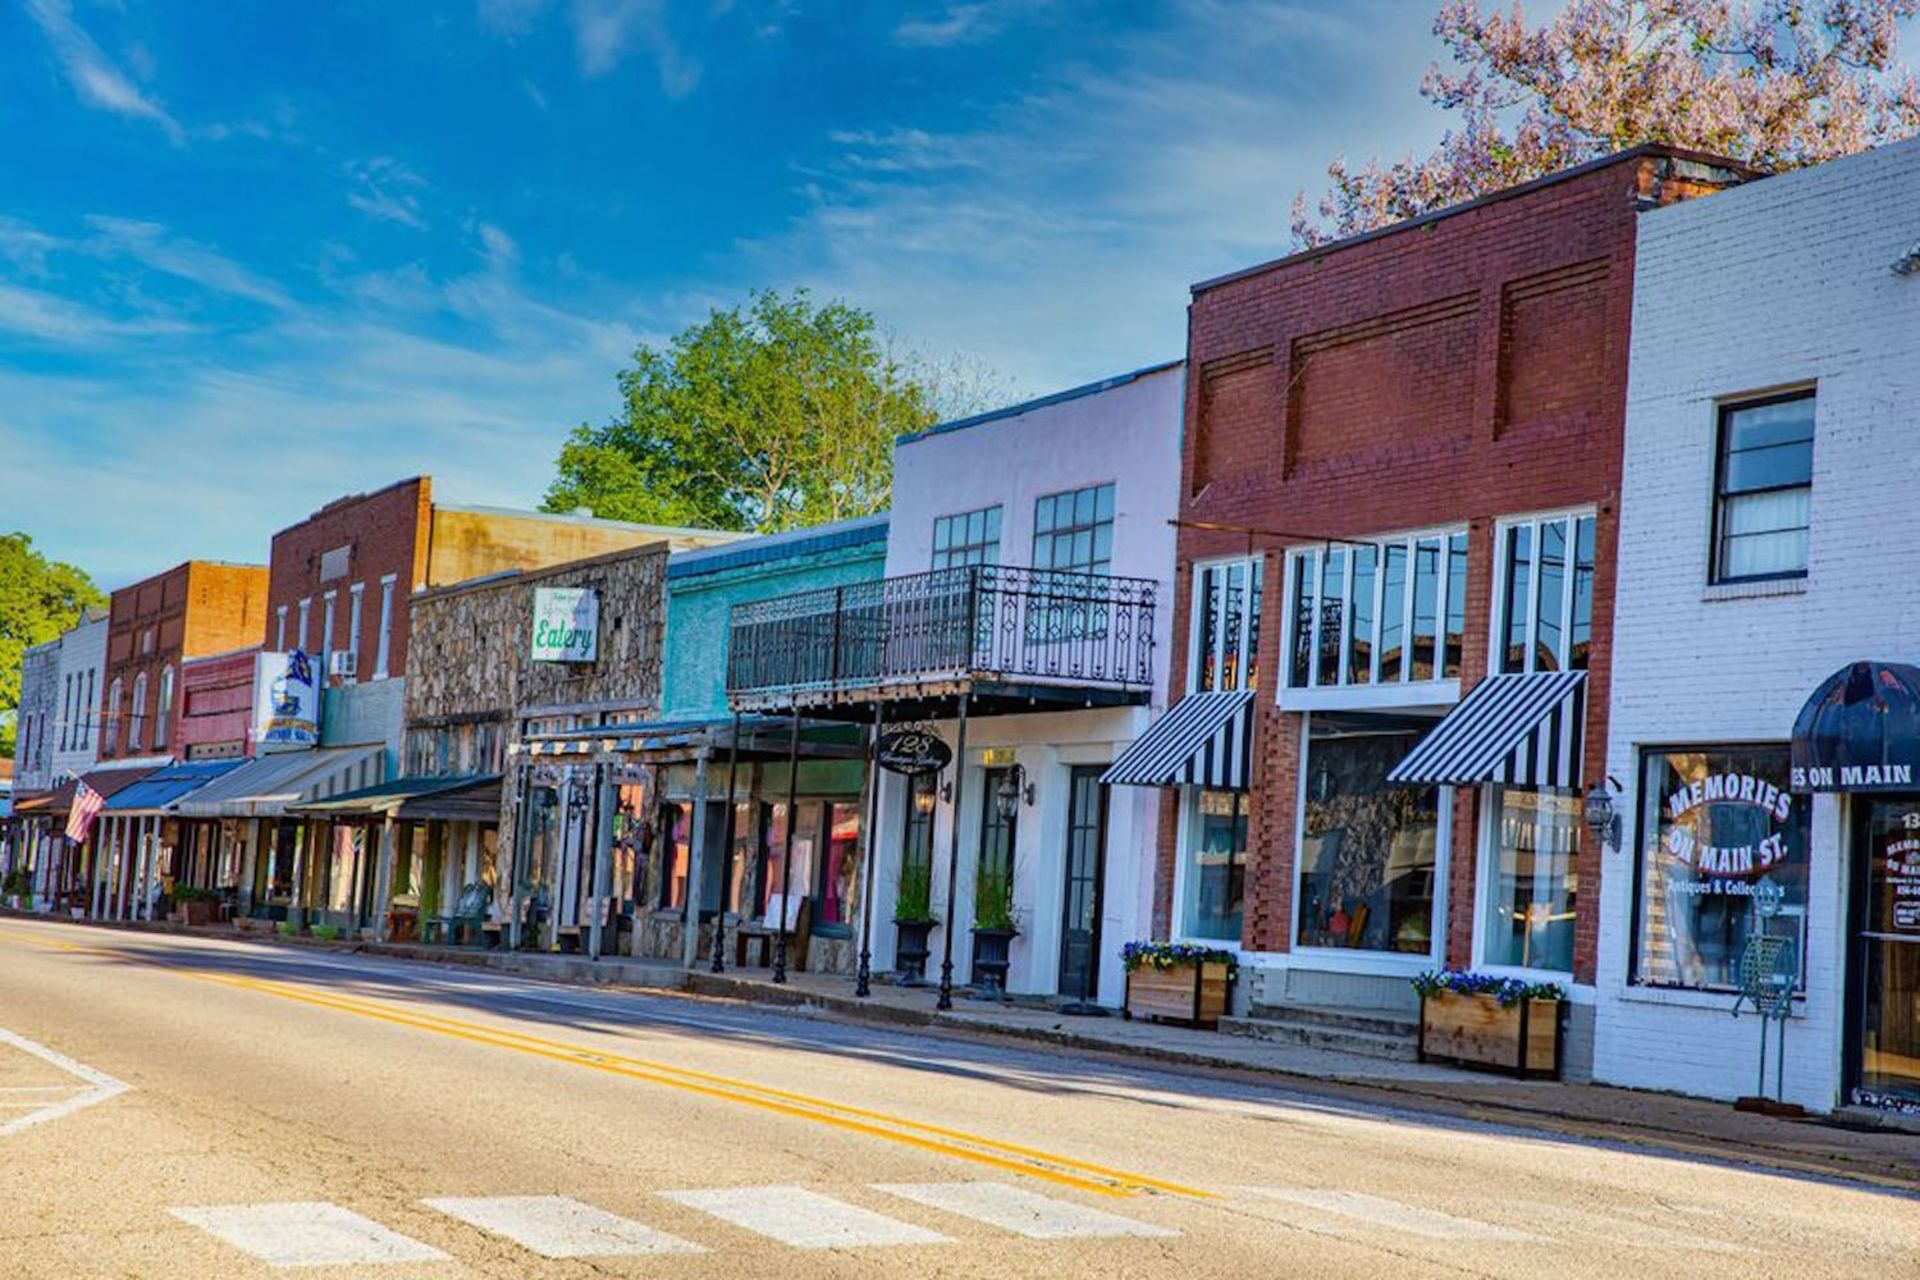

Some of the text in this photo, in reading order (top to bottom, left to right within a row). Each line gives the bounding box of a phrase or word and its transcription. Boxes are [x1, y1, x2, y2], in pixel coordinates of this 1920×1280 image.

[536, 619, 592, 657] Eatery
[889, 735, 934, 754] 128
[1809, 767, 1833, 787] ON
[1841, 765, 1911, 785] MAIN
[1669, 773, 1791, 820] MEMORIES
[1668, 829, 1788, 873] ON MAIN ST.
[1714, 880, 1722, 894] &
